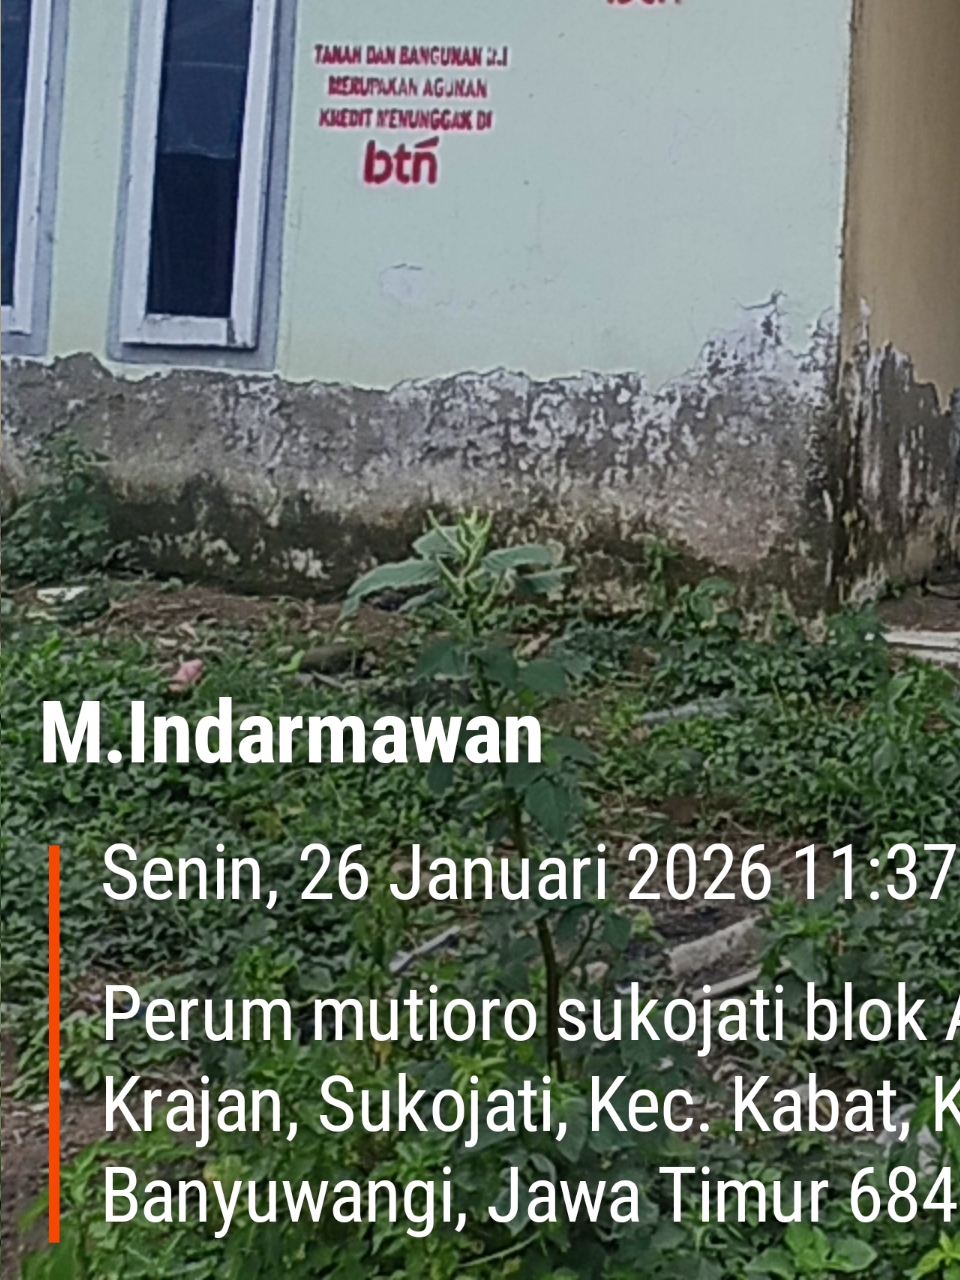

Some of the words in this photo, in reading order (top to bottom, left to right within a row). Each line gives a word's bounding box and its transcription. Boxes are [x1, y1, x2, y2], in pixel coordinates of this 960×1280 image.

[315, 44, 362, 65] TANAH
[366, 45, 396, 65] DAN
[399, 46, 481, 66] BANGUNAN
[319, 108, 373, 128] KREDIT
[476, 110, 493, 131] DI
